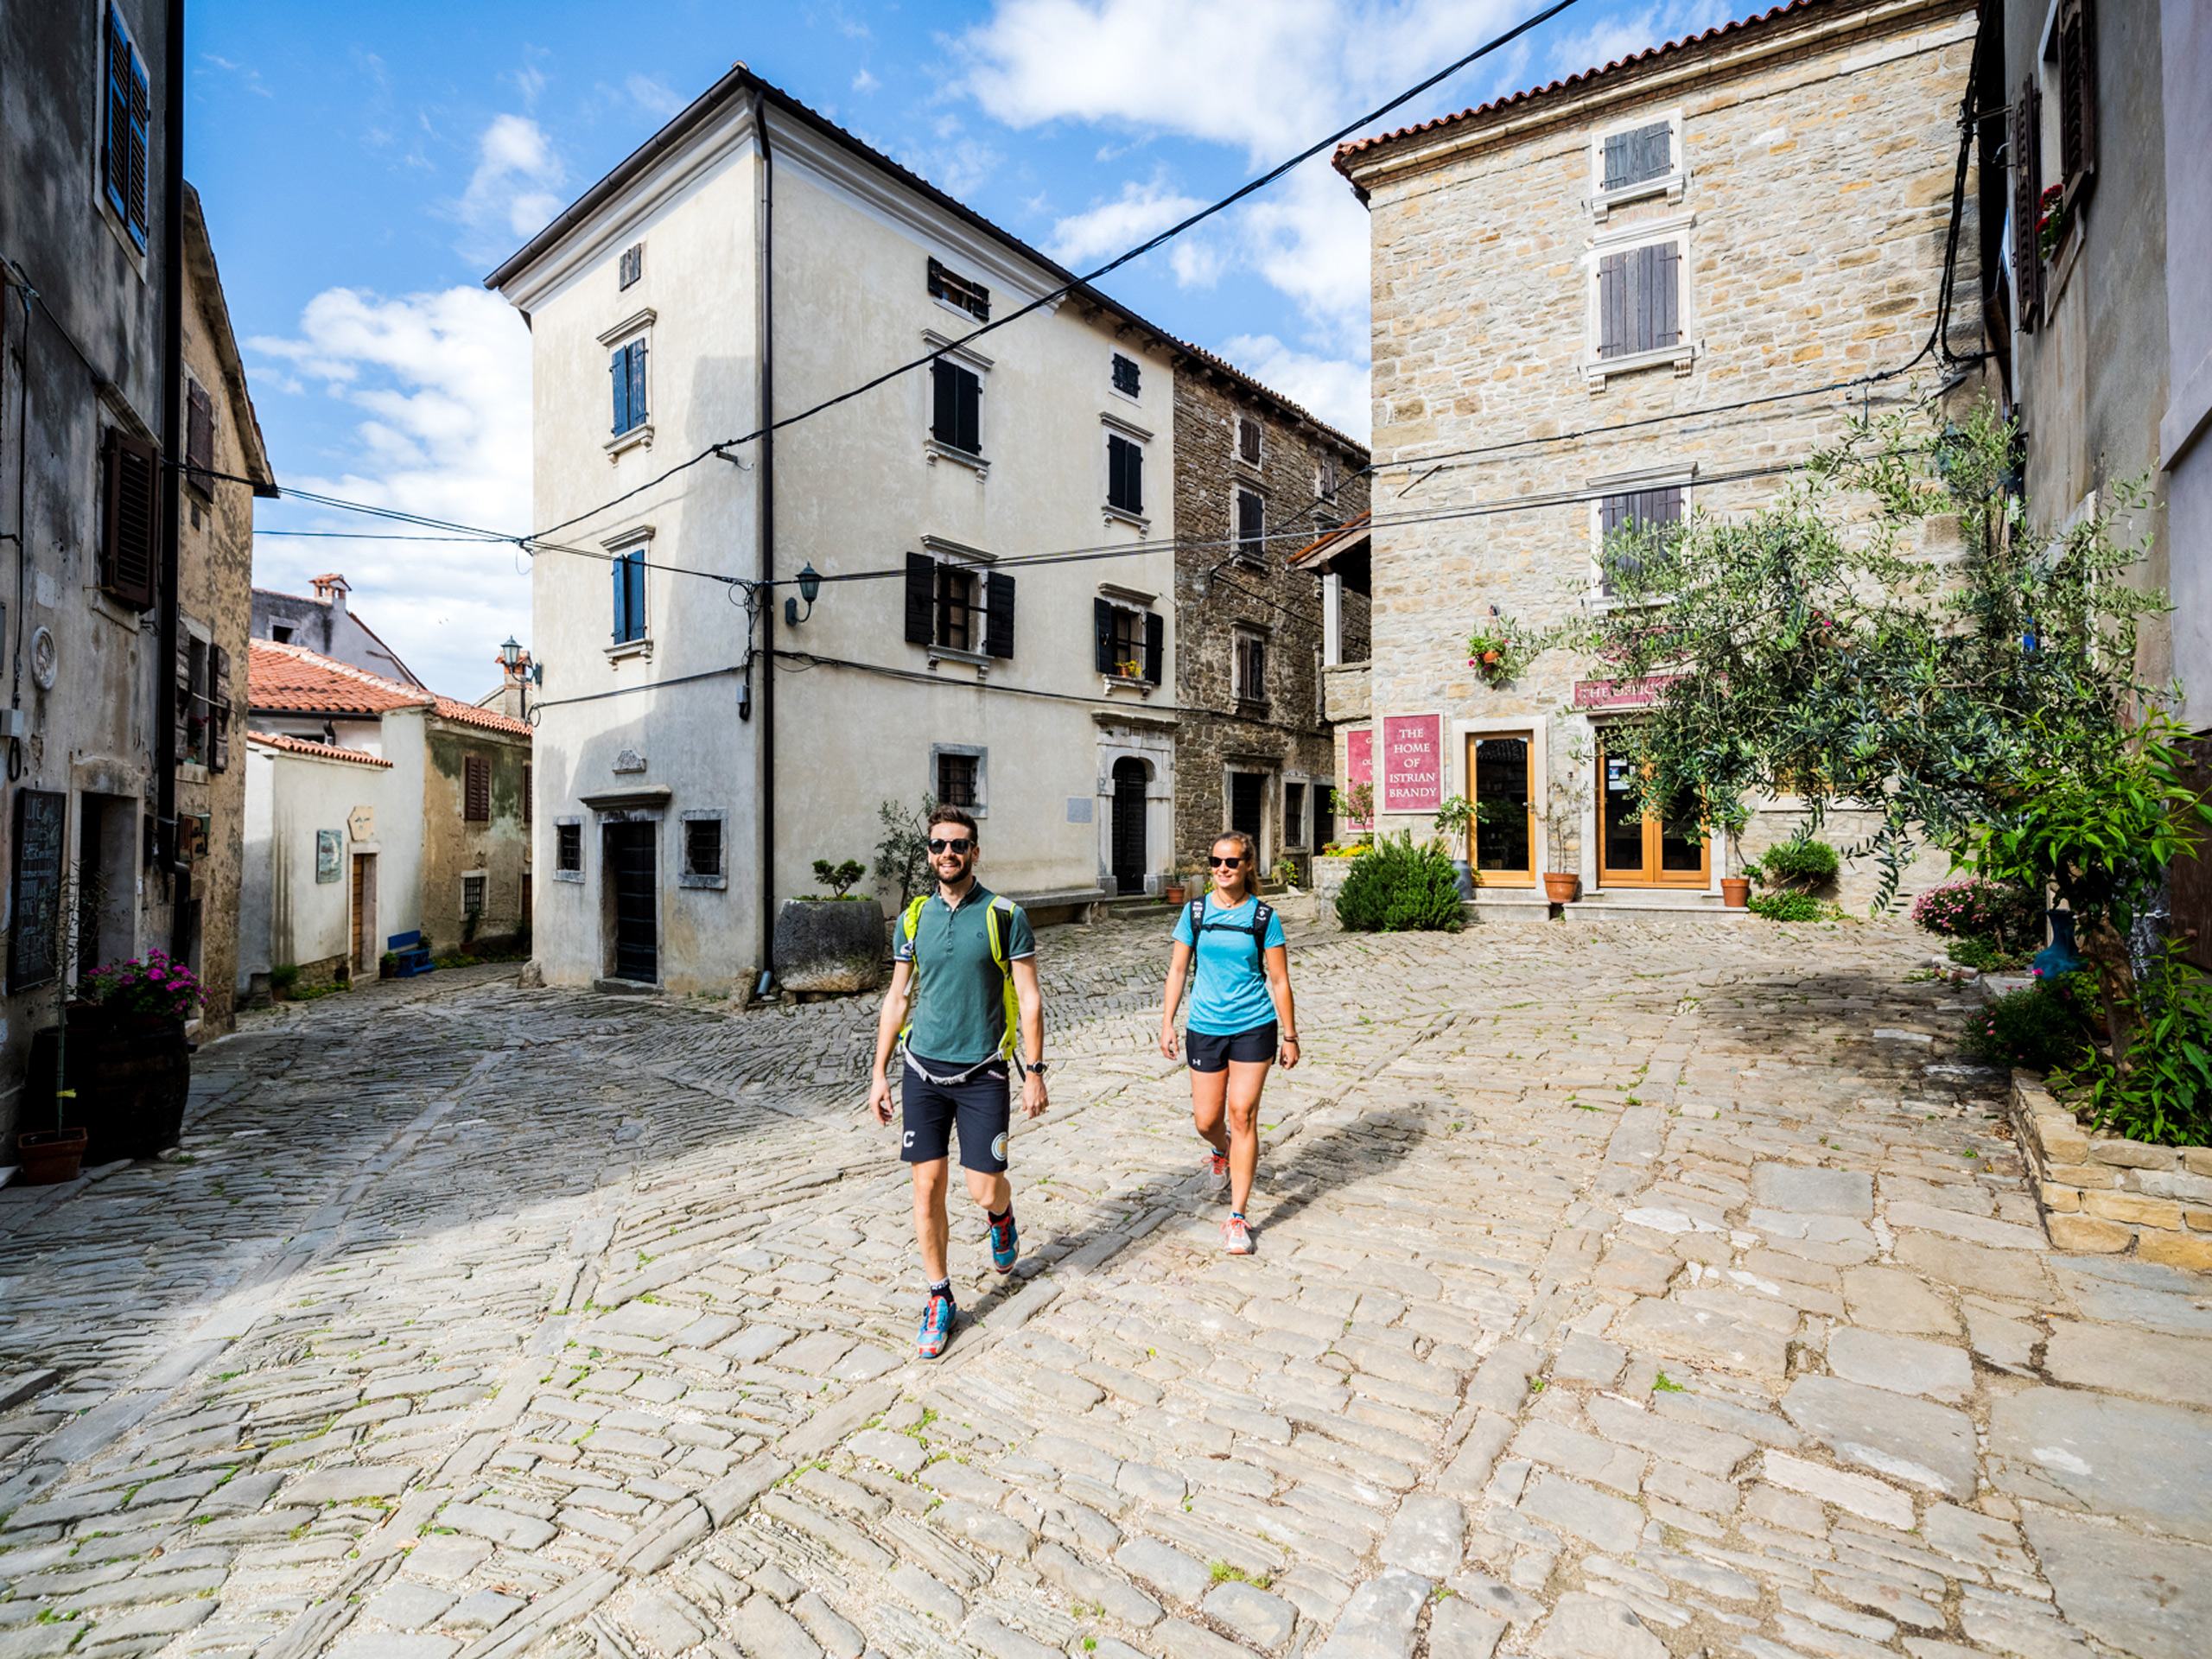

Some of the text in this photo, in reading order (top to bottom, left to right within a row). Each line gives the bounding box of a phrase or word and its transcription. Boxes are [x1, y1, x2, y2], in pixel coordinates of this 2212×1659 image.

[1580, 688, 1609, 699] THE
[1399, 728, 1424, 739] THE
[1394, 743, 1430, 754] HOME
[1403, 758, 1421, 768] OF
[1389, 772, 1435, 784] ISTRIAN
[1389, 787, 1437, 798] BRANDY
[904, 1131, 915, 1147] C
